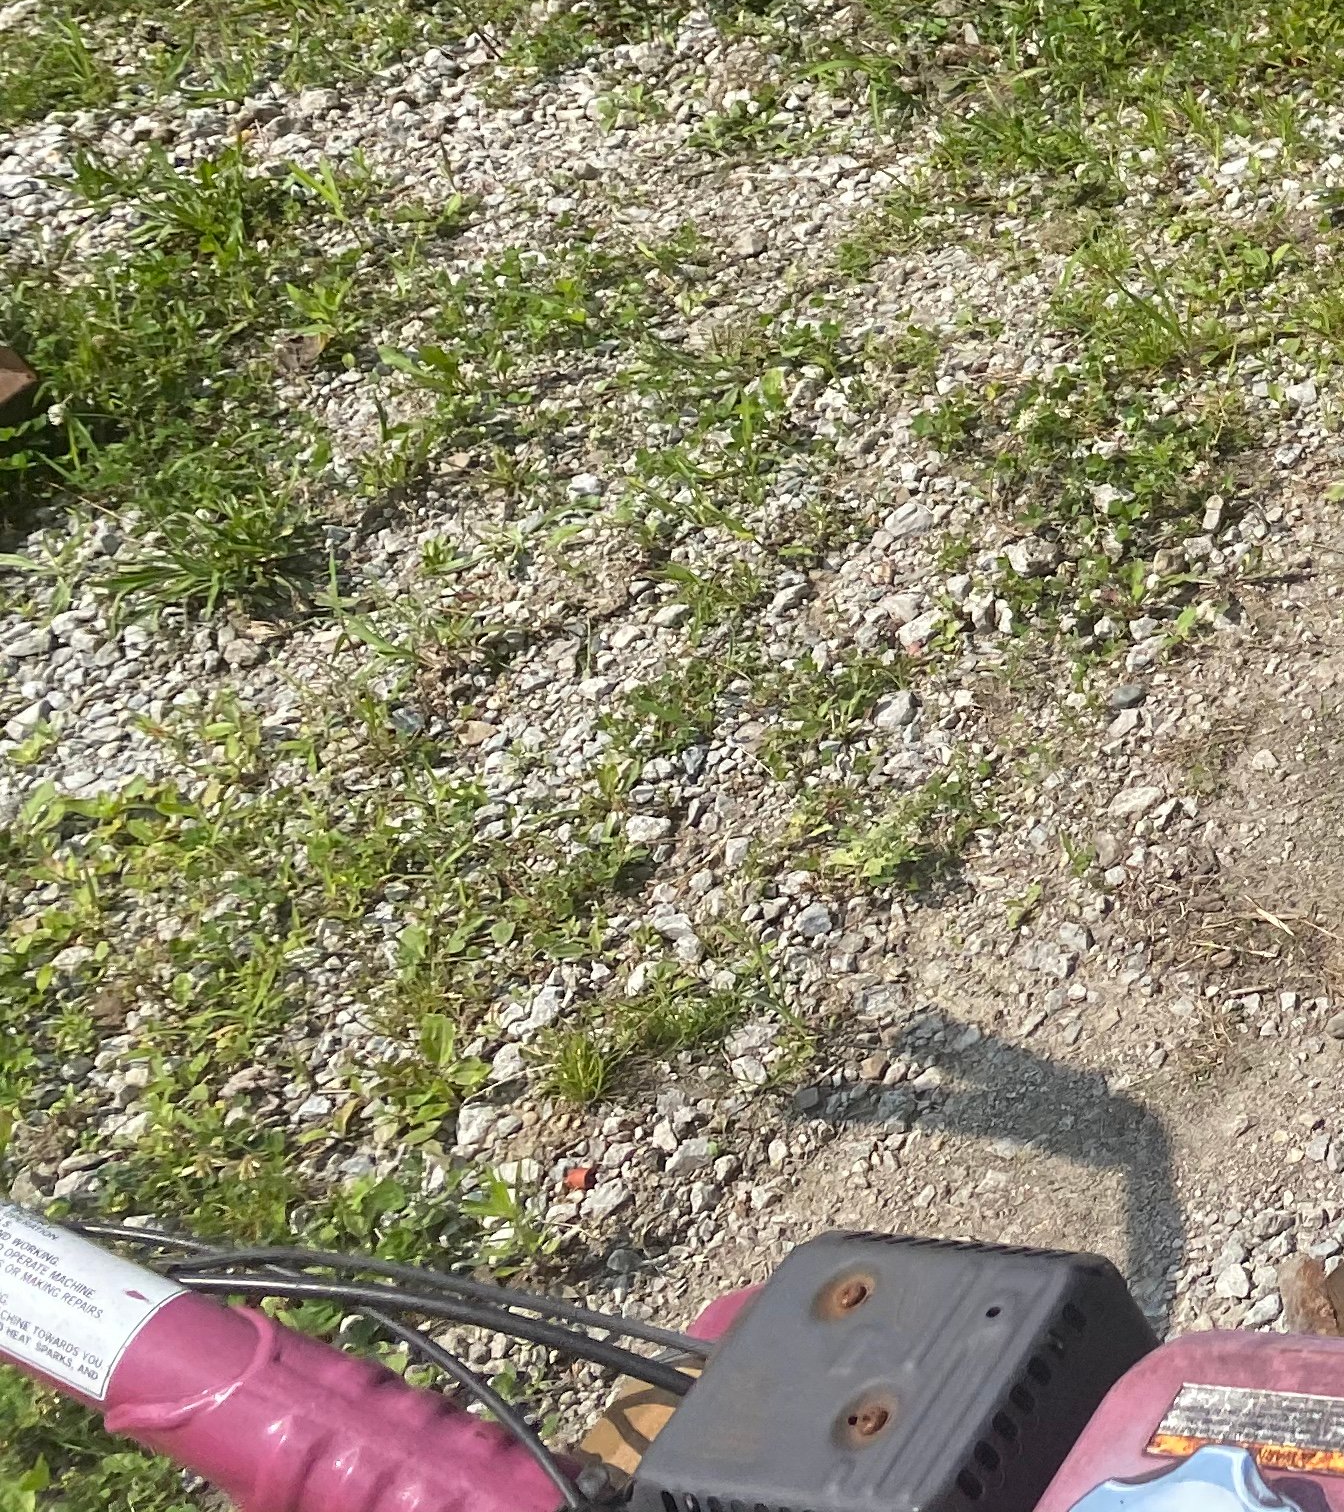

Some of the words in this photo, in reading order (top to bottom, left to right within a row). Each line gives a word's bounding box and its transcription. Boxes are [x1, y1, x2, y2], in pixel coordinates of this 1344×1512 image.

[4, 1248, 50, 1276] OPERATE
[4, 1263, 22, 1277] OR
[21, 1271, 61, 1298] MAKING
[6, 1327, 32, 1345] HEAT
[77, 1364, 99, 1380] AND
[33, 1325, 80, 1357] TOWARDS
